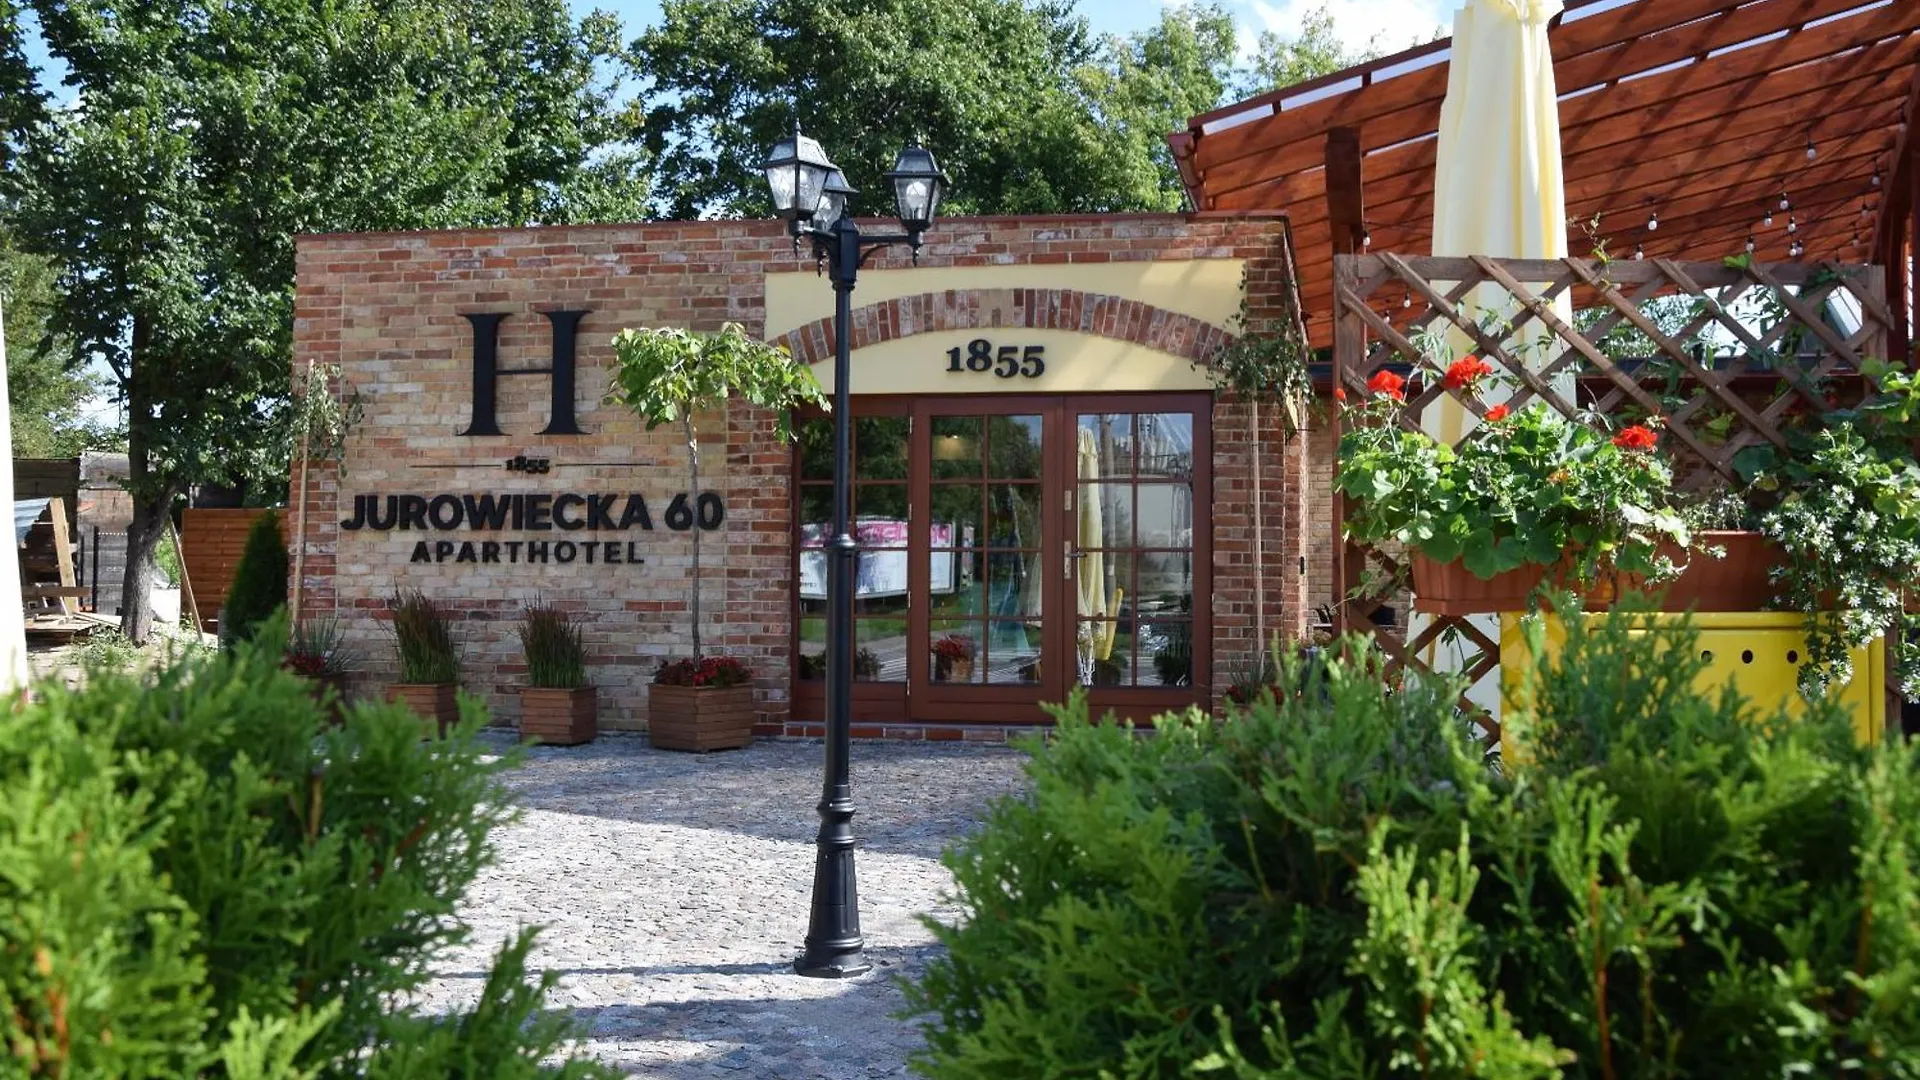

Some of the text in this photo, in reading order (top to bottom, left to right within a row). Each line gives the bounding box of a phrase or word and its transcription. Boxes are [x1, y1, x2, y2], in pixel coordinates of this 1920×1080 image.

[455, 310, 598, 437] H
[946, 339, 1046, 379] 1855
[505, 456, 550, 474] 1855
[340, 491, 725, 531] JUROWIECKA 60
[410, 540, 645, 564] APARTHOTEL
